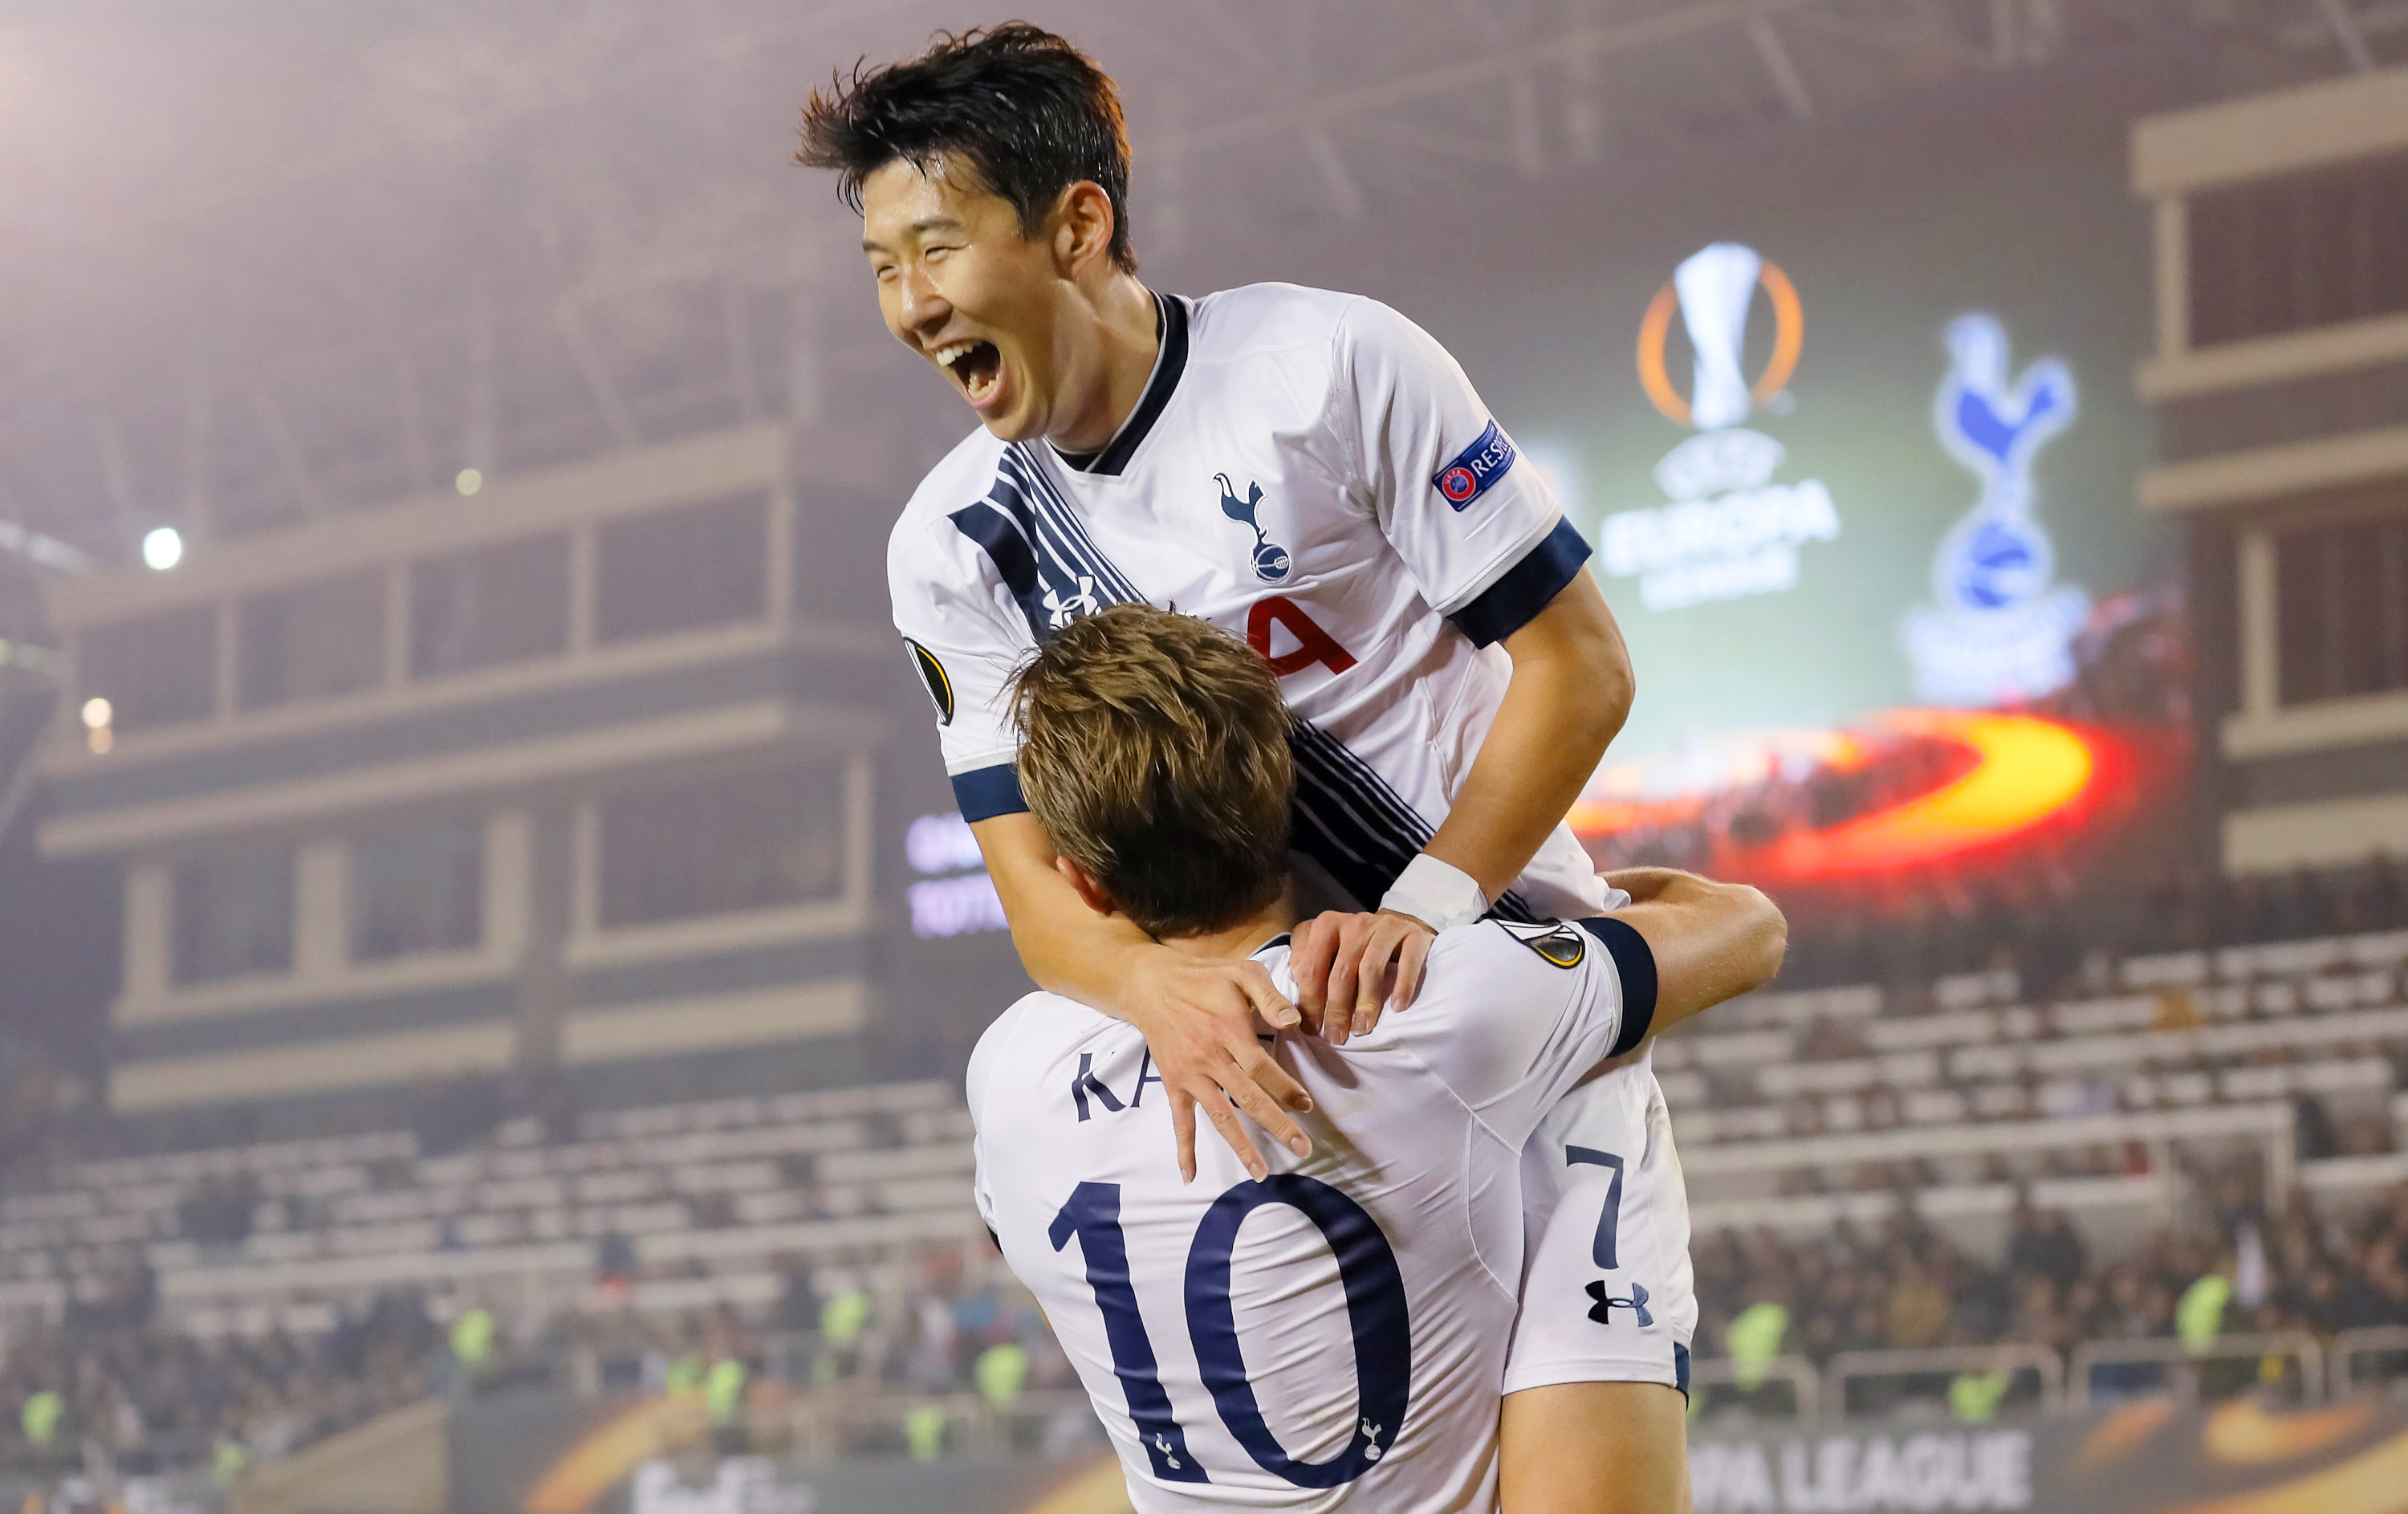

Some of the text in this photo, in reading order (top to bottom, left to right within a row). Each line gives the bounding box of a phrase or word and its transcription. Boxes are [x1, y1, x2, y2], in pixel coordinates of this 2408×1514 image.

[1445, 469, 1462, 484] UEFA
[1470, 431, 1509, 477] RESPEC
[1601, 479, 1839, 576] EUROPA
[1565, 1144, 1624, 1270] 7
[1047, 1173, 1411, 1489] 10
[1780, 1430, 2033, 1512] LEAGUE
